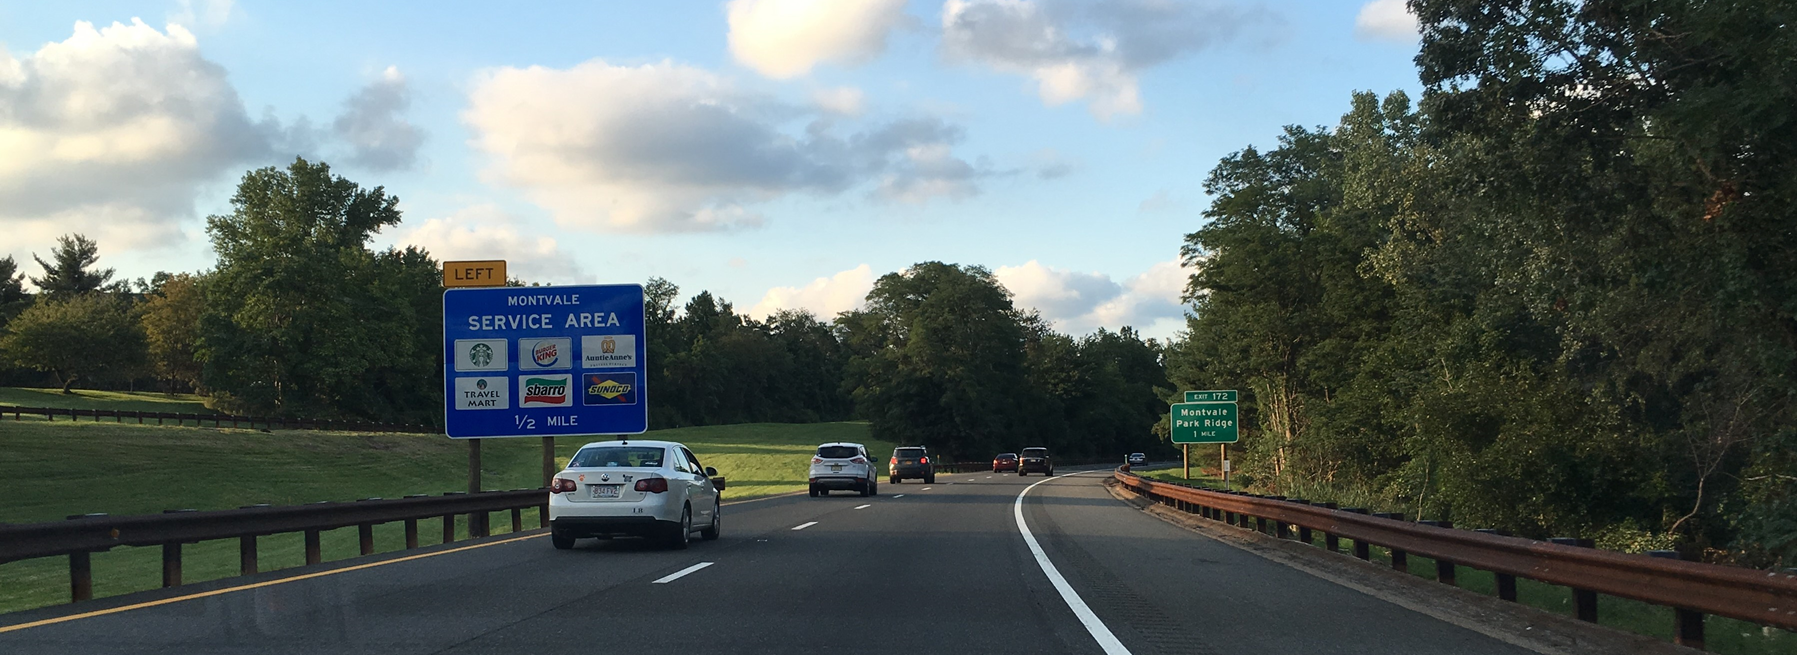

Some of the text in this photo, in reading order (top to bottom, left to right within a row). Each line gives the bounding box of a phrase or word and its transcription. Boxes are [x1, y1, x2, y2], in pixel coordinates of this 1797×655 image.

[455, 268, 494, 280] LEFT
[508, 295, 580, 306] MONTVALE
[468, 312, 620, 331] SERVICE AREA
[535, 344, 557, 355] BURGER
[536, 349, 557, 362] KING
[464, 390, 500, 398] TRAVEL
[526, 384, 566, 396] sbarro
[589, 385, 629, 394] SUNOCO
[1181, 408, 1228, 416] Montvale
[514, 415, 578, 429] 1/2 MILE
[1176, 419, 1233, 428] Park Ridge
